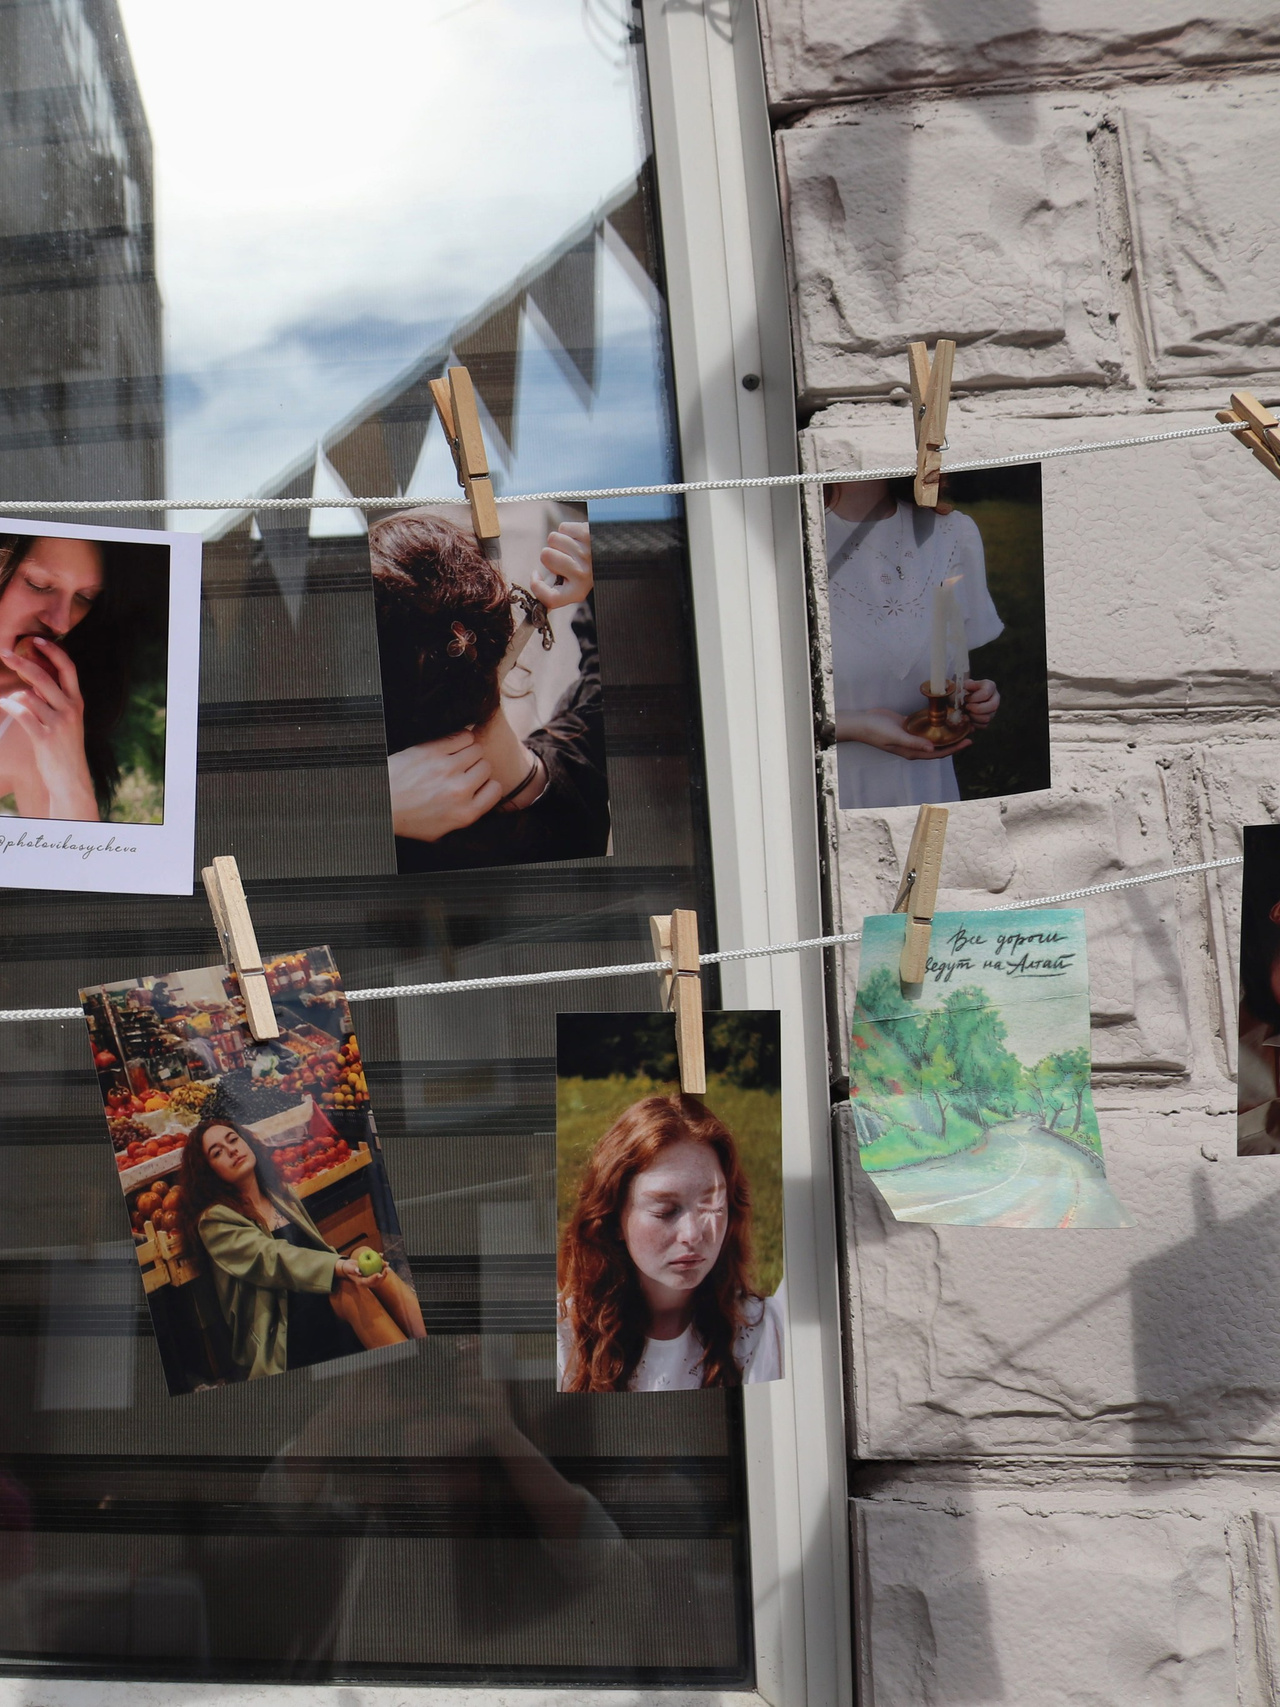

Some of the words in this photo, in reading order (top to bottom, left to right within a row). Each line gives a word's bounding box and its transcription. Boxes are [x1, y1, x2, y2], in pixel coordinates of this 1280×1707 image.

[946, 922, 988, 956] Все
[996, 930, 1069, 956] дороги
[983, 961, 1007, 971] на
[1006, 952, 1077, 976] Алтай
